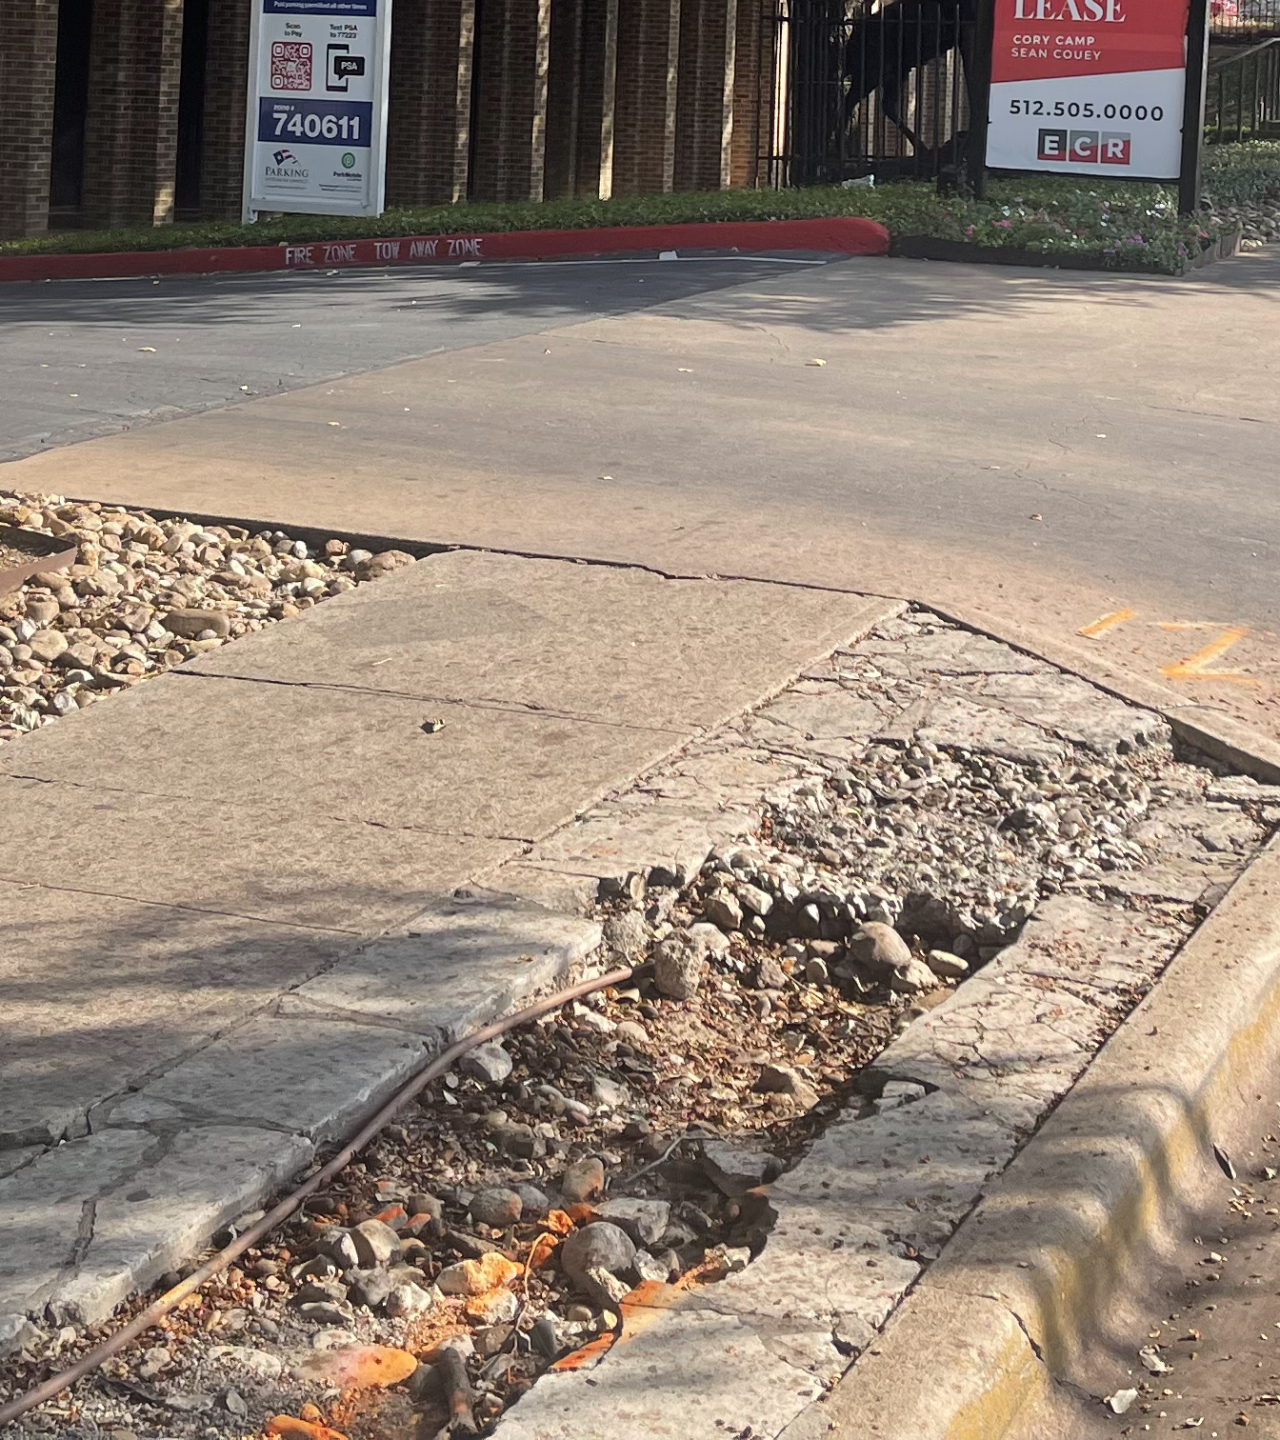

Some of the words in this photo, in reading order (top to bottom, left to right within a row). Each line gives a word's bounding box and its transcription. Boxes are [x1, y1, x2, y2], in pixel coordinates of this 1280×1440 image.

[1013, 35, 1050, 45] CORY
[1055, 36, 1095, 45] CAMP
[1011, 48, 1048, 58] SEAN
[1053, 49, 1101, 60] COUEY
[341, 62, 358, 71] PSA
[1009, 100, 1163, 121] 512.505.0000
[273, 113, 359, 139] 740611
[1044, 135, 1124, 158] ECR
[285, 247, 315, 264] FIRE
[322, 244, 357, 263] ZONE
[374, 242, 400, 260] TOW
[409, 240, 438, 259] AWAY
[447, 239, 484, 257] ZONE
